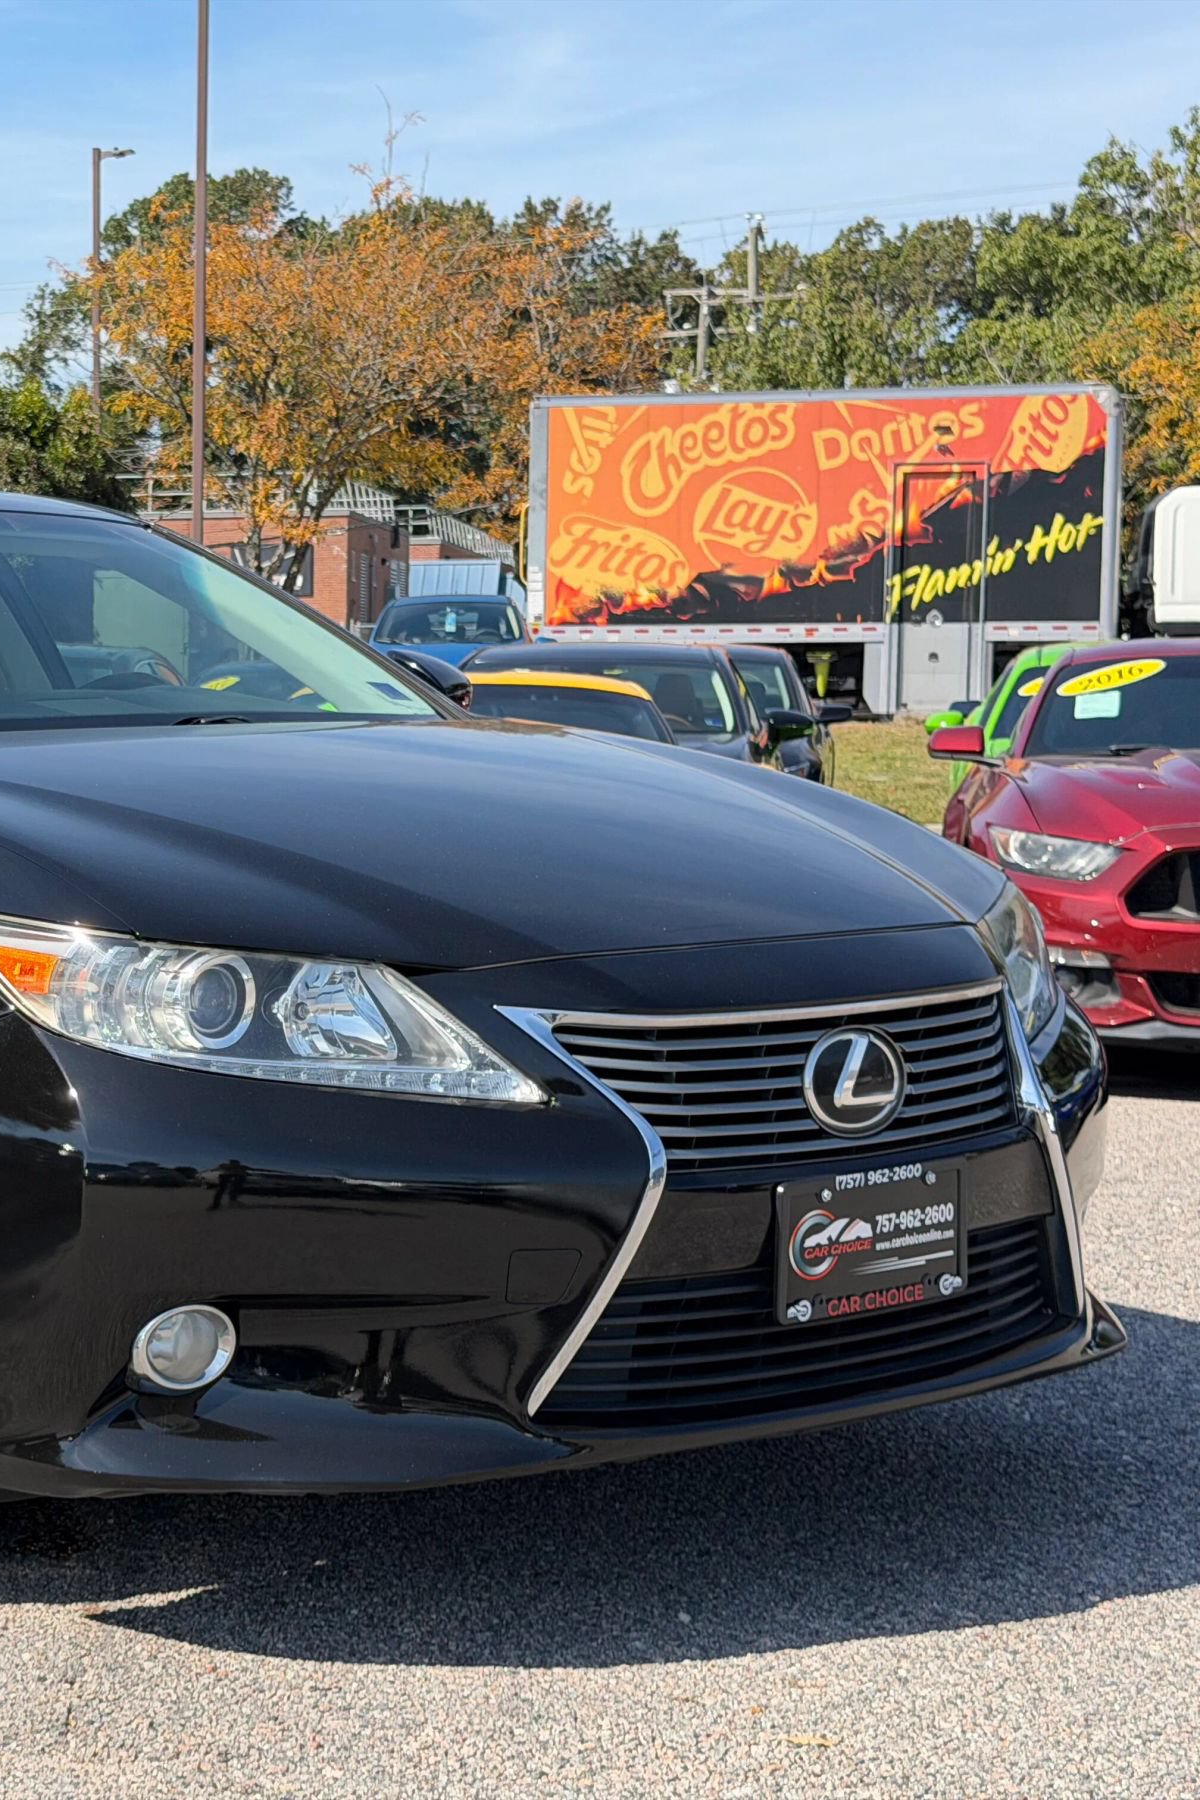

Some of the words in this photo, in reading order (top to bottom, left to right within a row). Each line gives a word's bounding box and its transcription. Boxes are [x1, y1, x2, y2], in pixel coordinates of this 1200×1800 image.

[624, 403, 793, 514] Cheetos
[812, 402, 985, 471] Doritos
[699, 487, 811, 555] Lay's
[550, 516, 687, 588] Fritos
[885, 534, 1023, 624] Flamin'
[1025, 512, 1104, 565] Hot
[1078, 665, 1143, 691] 2016
[835, 1172, 865, 1191] (757)
[867, 1163, 922, 1186] 962-2600
[875, 1202, 954, 1234] 757-962-2600
[804, 1247, 829, 1260] CAR
[830, 1238, 873, 1255] CHOICE
[827, 1296, 862, 1317] CAR
[864, 1284, 925, 1310] CHOICE
